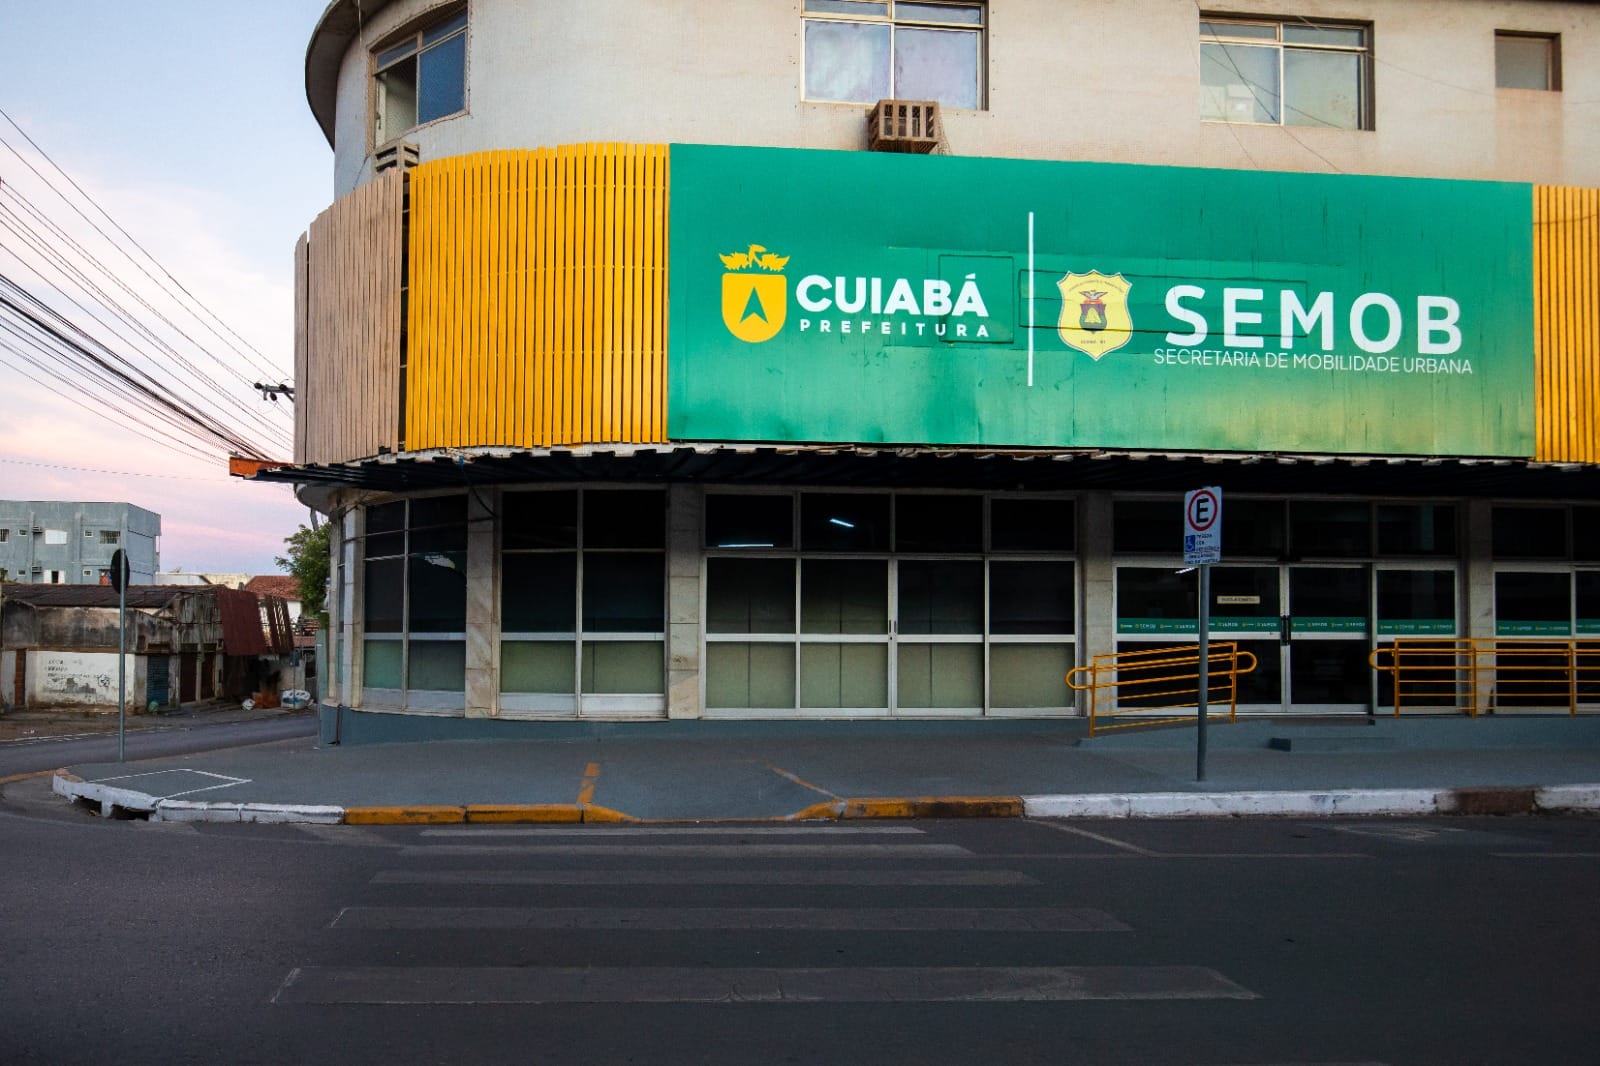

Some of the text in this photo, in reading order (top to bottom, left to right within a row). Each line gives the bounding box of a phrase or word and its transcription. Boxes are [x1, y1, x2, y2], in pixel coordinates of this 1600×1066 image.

[796, 273, 989, 317] CUIABÁ
[800, 319, 989, 337] PREFEITURA
[1165, 285, 1462, 355] SEMOB
[1153, 348, 1473, 375] SECRETARIA DE MOBILIDADE URBANA
[1196, 497, 1209, 523] E
